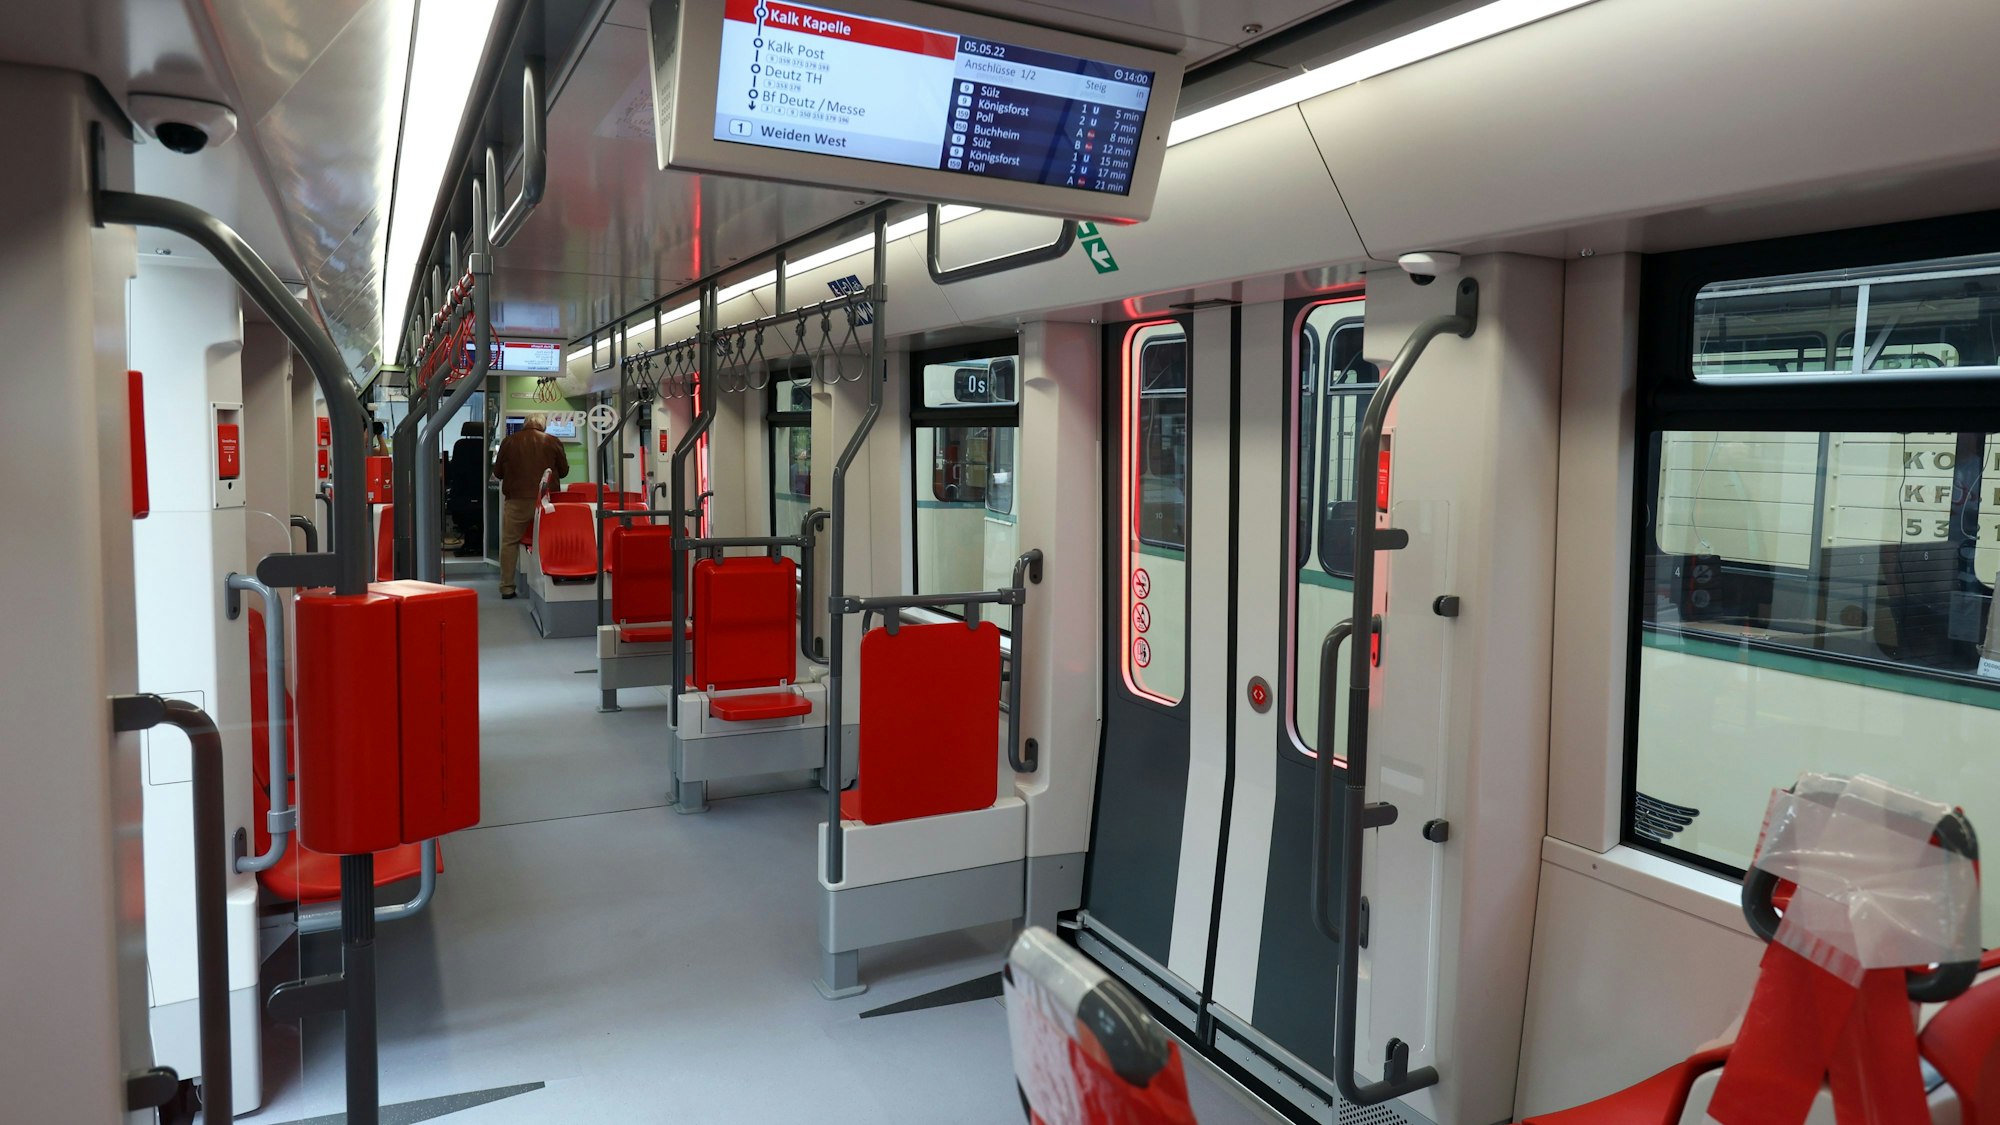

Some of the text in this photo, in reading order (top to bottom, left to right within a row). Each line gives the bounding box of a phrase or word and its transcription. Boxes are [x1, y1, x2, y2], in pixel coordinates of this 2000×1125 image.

[770, 9, 851, 35] Kalk Kapelle
[768, 40, 825, 60] Kalk Post
[964, 41, 1005, 58] 05.05.22
[765, 65, 822, 85] Deutz TH
[965, 59, 1016, 76] Anschlüsse
[1021, 69, 1037, 80] 1/2
[1124, 72, 1148, 84] 14:00
[1085, 80, 1107, 94] Steig
[1136, 90, 1144, 98] in
[763, 90, 776, 102] Bf
[780, 94, 815, 109] Deutz
[981, 86, 1000, 98] Sülz
[1082, 104, 1087, 113] 1
[1115, 110, 1122, 119] 5
[1123, 112, 1139, 122] min
[978, 99, 1030, 116] Königsforst
[1079, 116, 1085, 126] 2
[1113, 122, 1119, 131] 7
[1120, 124, 1137, 134] min
[738, 123, 846, 148] 1 Weiden West
[976, 111, 994, 123] Poll
[1076, 129, 1083, 138] A
[1110, 134, 1116, 143] 8
[1117, 136, 1134, 146] min
[974, 124, 1020, 140] Buchheim
[1074, 141, 1081, 150] B
[1102, 145, 1113, 154] 12
[1114, 148, 1131, 157] min
[972, 137, 991, 148] Sülz
[1072, 152, 1078, 162] 1
[1100, 156, 1110, 166] 15
[1112, 159, 1129, 169] min
[970, 149, 1020, 166] Königsforst
[1070, 164, 1076, 174] 2
[1098, 168, 1109, 178] 17
[1110, 171, 1126, 180] min
[968, 161, 986, 172] Poll
[1066, 176, 1074, 185] A
[1095, 180, 1105, 190] 21
[1107, 183, 1124, 193] min
[968, 375, 988, 393] Os
[546, 411, 587, 427] KVB
